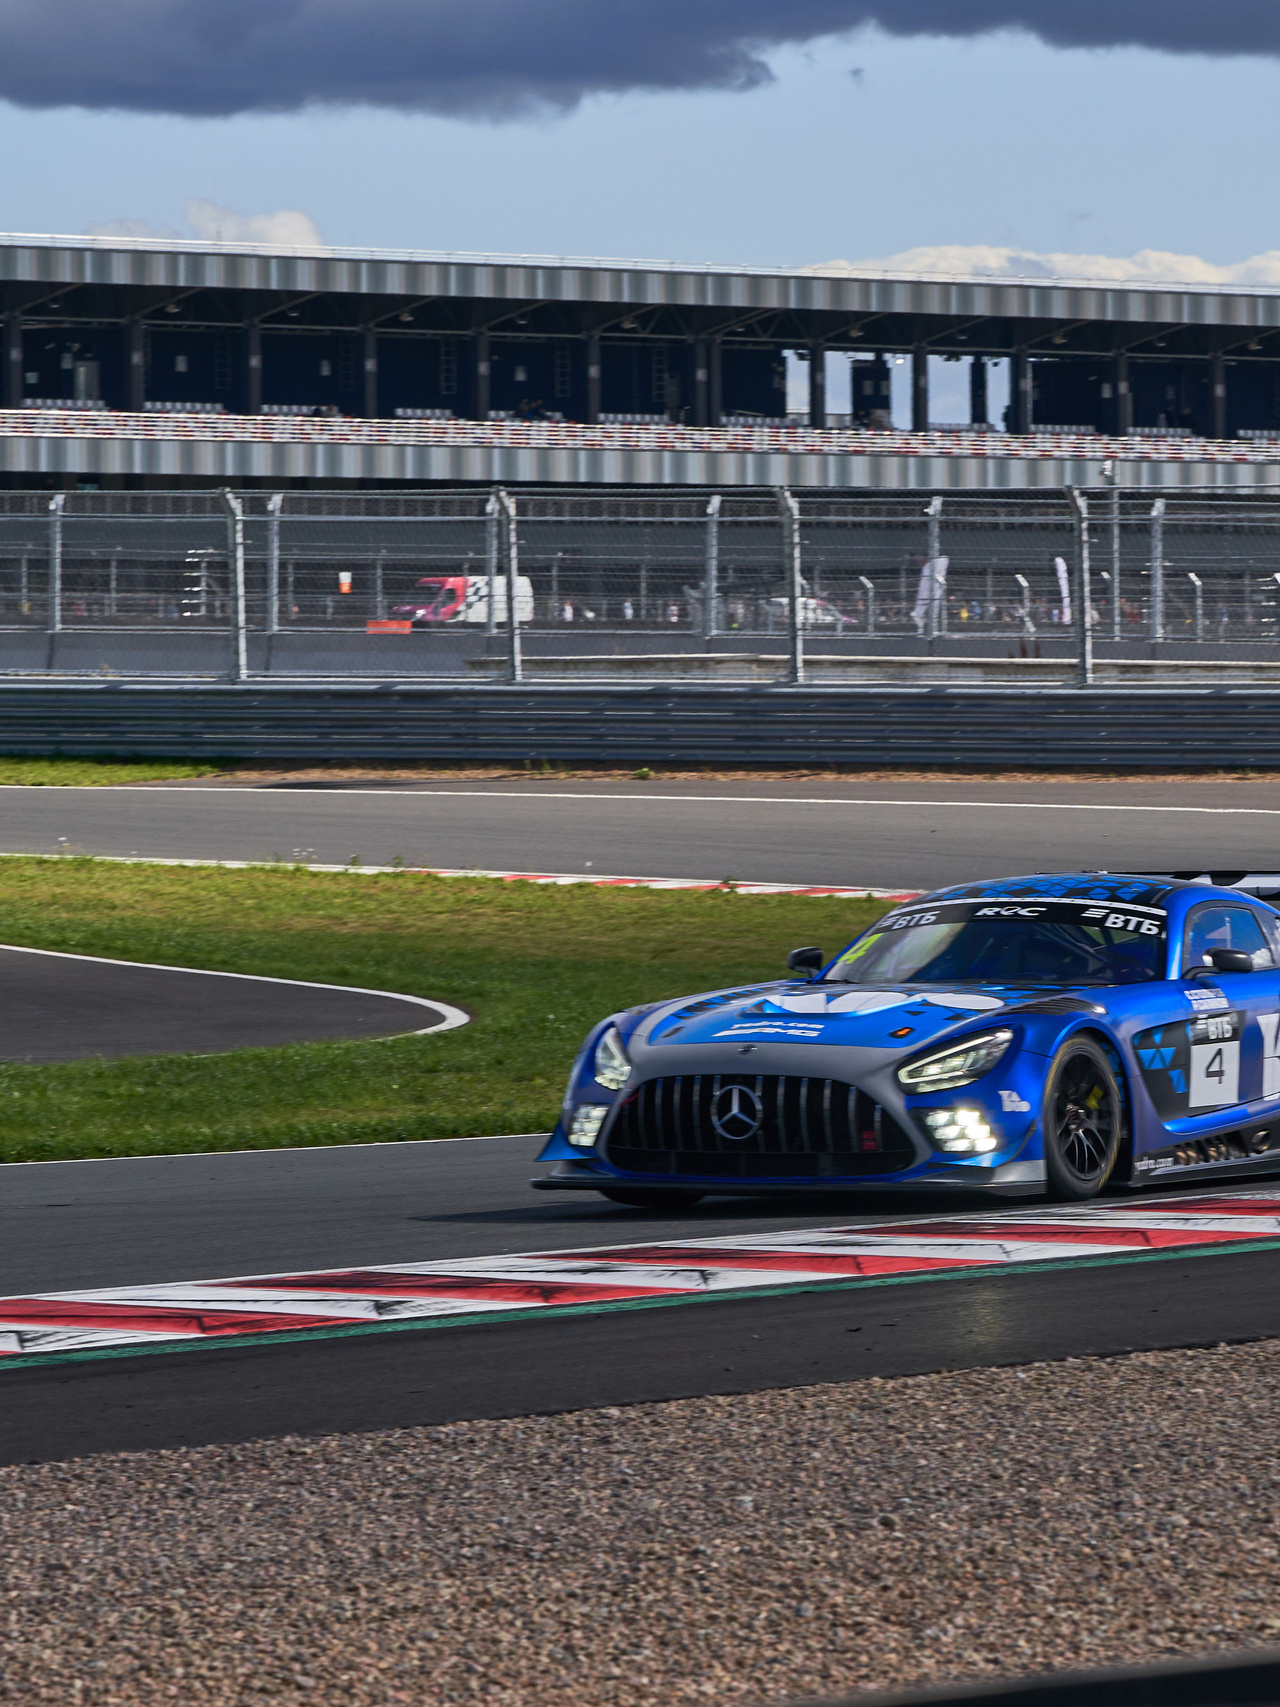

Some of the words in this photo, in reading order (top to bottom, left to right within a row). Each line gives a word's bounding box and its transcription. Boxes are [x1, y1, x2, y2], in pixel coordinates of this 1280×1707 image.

[891, 911, 941, 930] ВТБ
[1104, 913, 1161, 936] ВТБ
[836, 933, 884, 965] 4
[1207, 1016, 1233, 1040] ВТБ
[1205, 1047, 1225, 1085] 4
